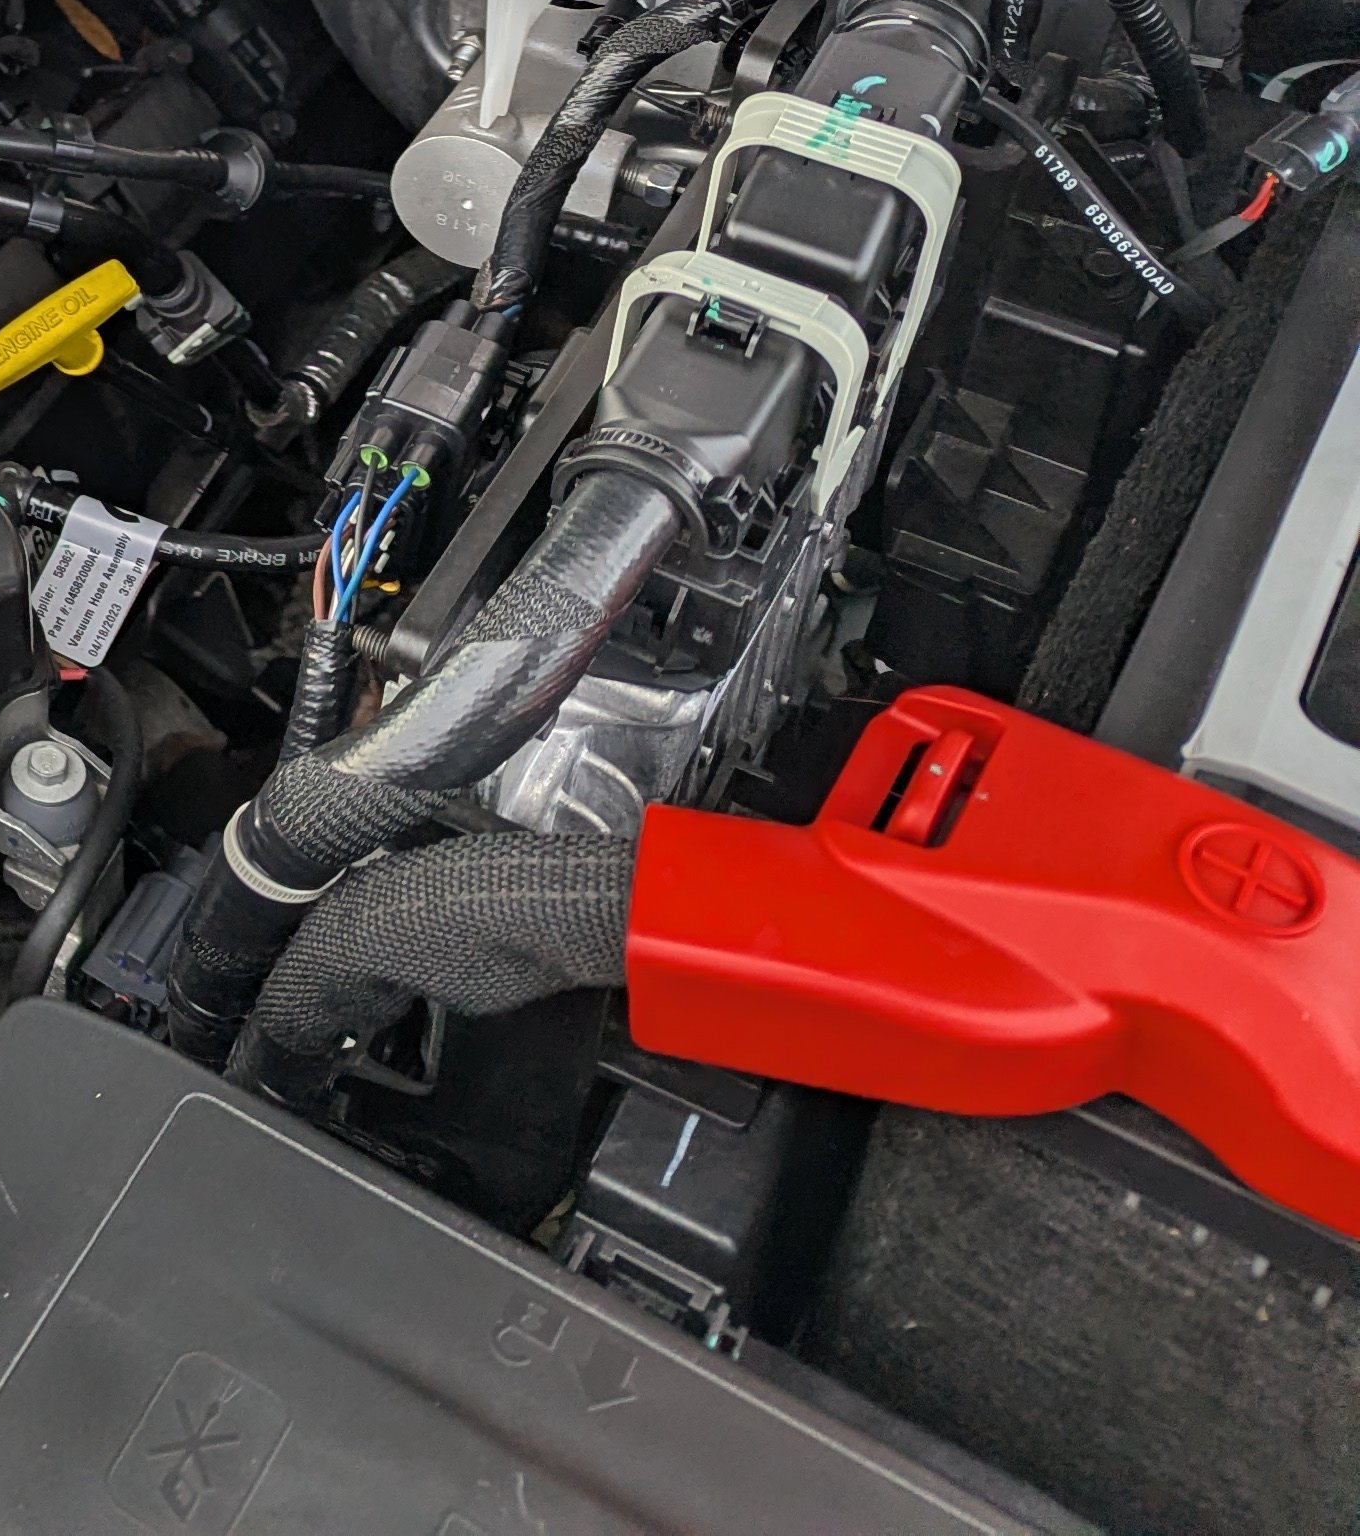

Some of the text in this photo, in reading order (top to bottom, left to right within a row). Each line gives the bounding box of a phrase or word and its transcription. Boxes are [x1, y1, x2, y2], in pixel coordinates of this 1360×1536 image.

[1035, 145, 1077, 191] 61789
[1085, 204, 1174, 295] 68366240AD
[63, 288, 98, 317] OIL
[52, 549, 76, 579] 58362
[216, 547, 287, 565] BRAKE
[67, 532, 132, 648] Vacuum Hose Assembly
[88, 557, 146, 658] 04/18/2023 3:36 pm
[47, 616, 66, 639] Part
